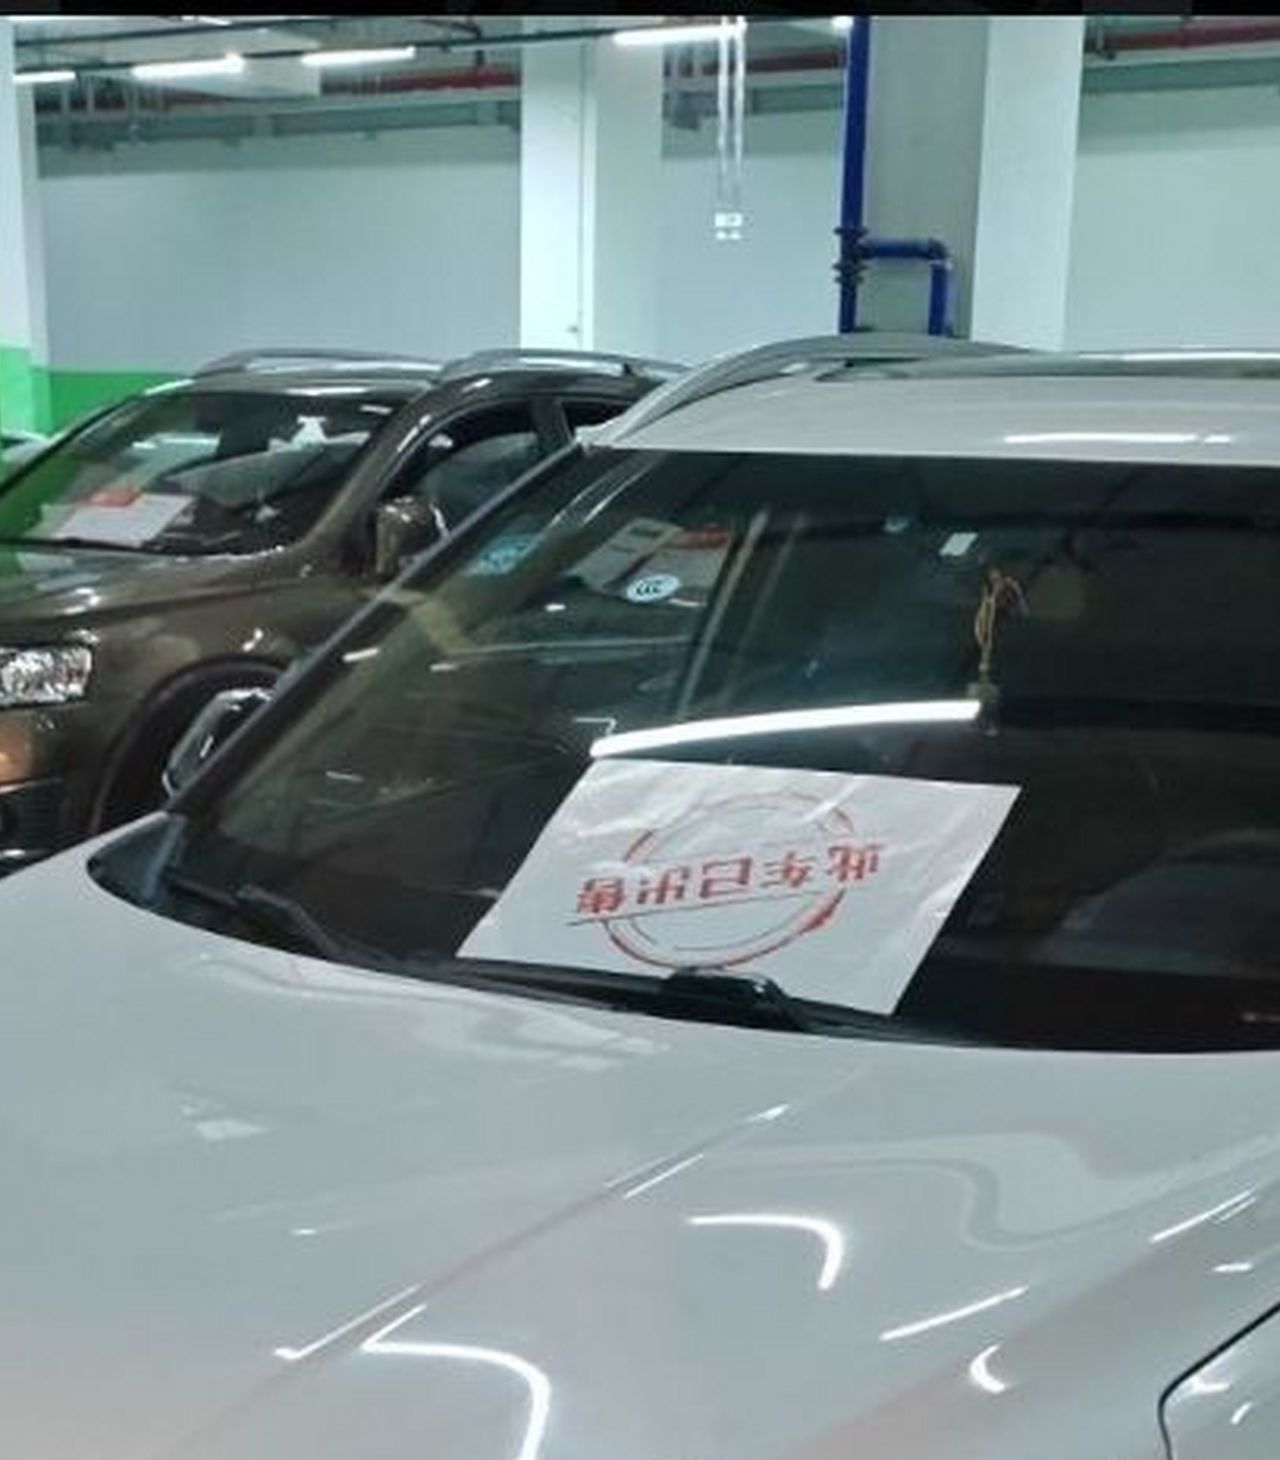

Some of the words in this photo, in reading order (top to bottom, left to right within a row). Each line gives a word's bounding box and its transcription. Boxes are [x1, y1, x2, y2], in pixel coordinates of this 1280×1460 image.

[576, 844, 882, 915] 此车已出售
